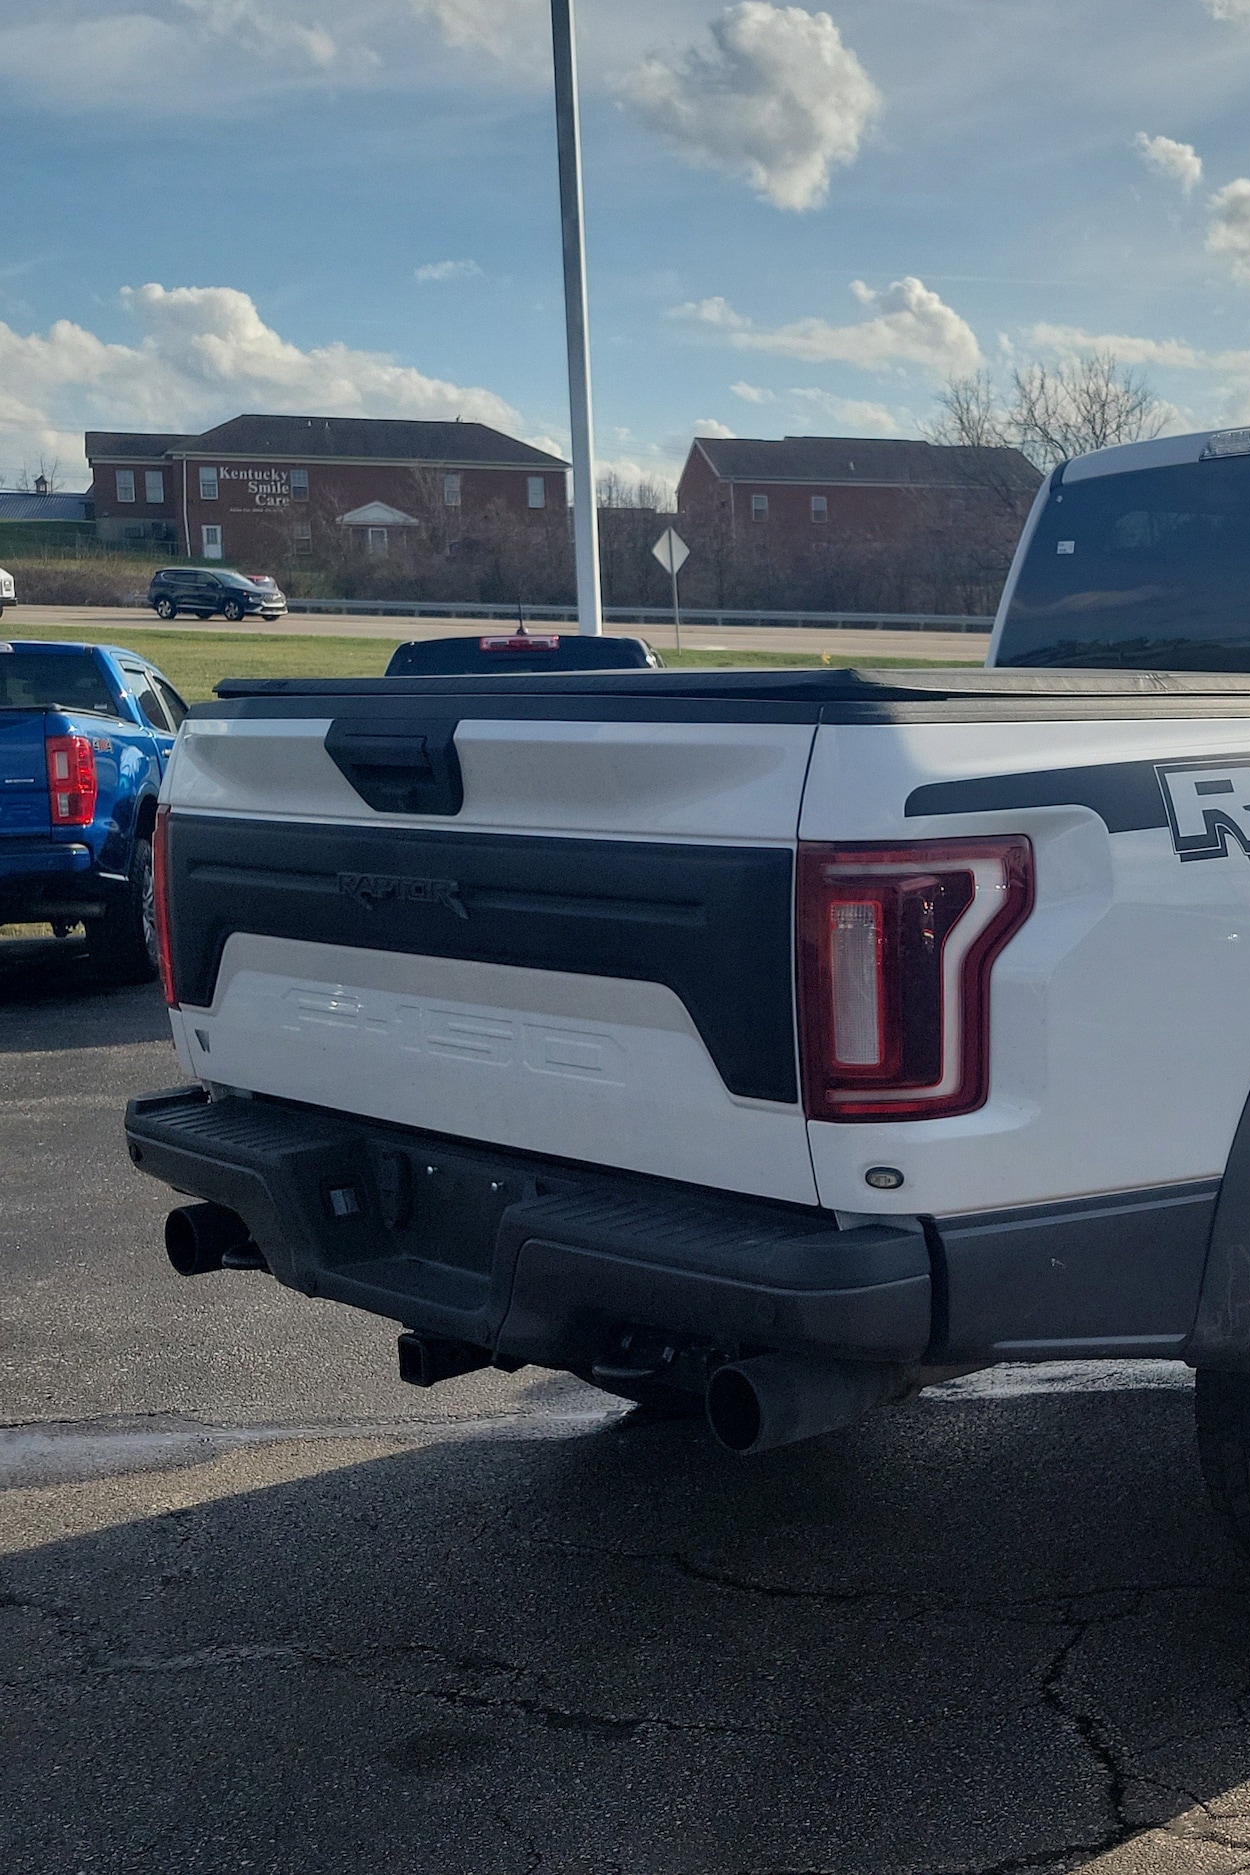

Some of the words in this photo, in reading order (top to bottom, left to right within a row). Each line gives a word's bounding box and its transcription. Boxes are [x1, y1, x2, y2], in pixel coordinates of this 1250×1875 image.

[219, 466, 288, 483] Kentucky
[247, 481, 290, 495] Smile
[255, 493, 290, 507] Care
[337, 871, 470, 920] RAPTOR
